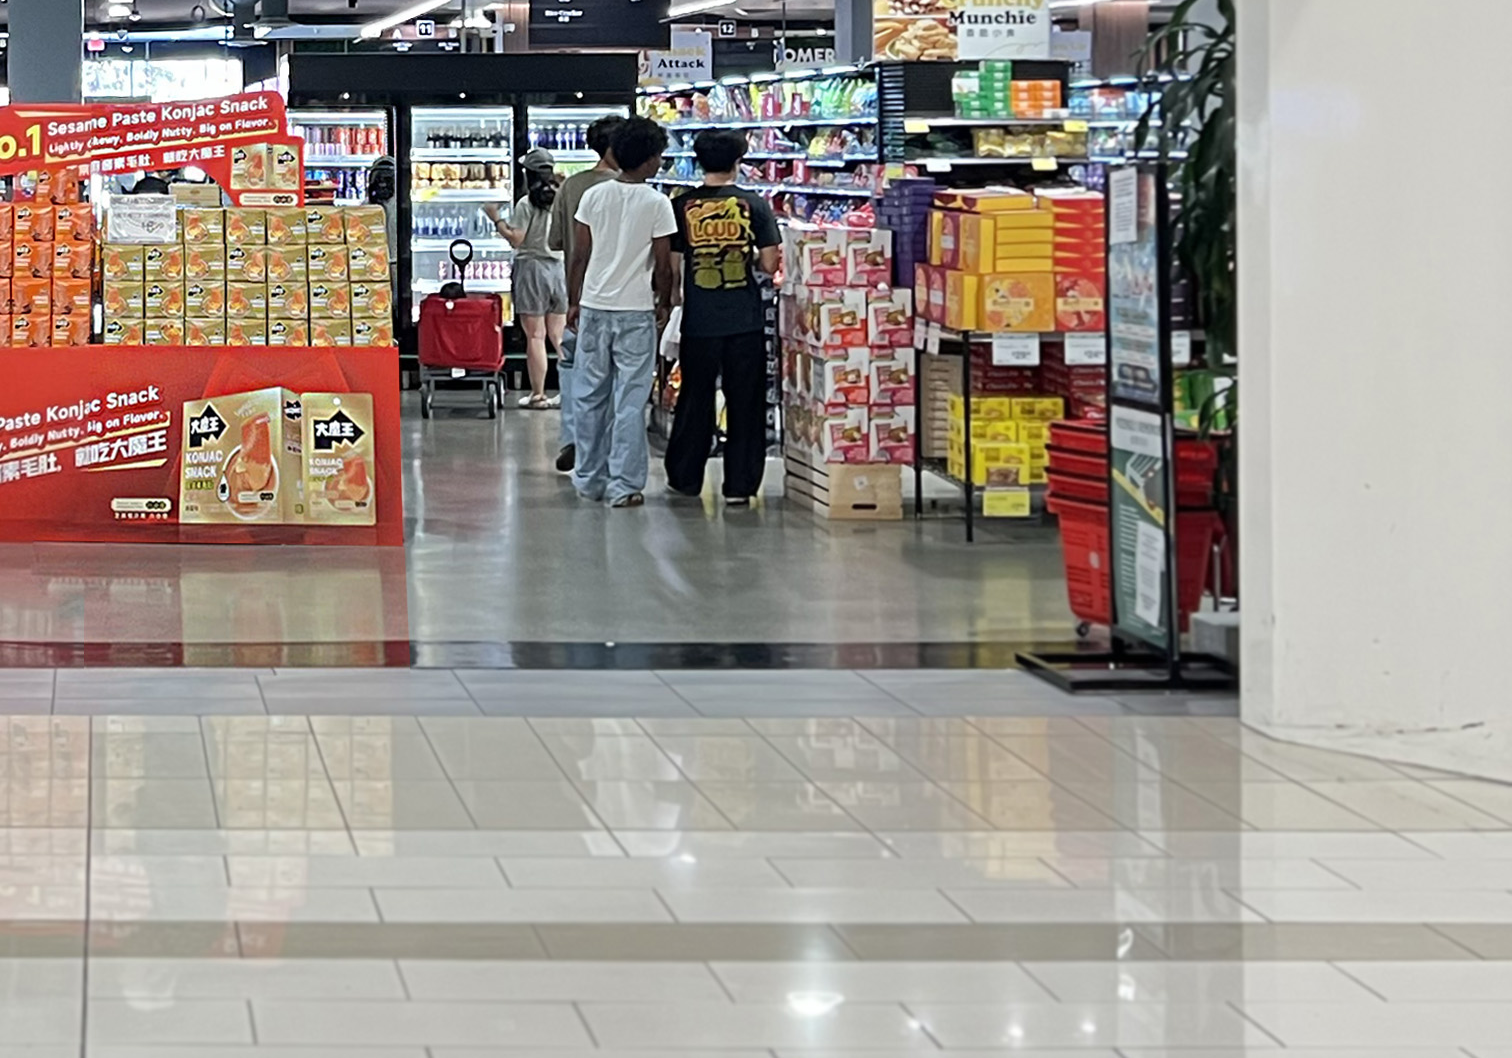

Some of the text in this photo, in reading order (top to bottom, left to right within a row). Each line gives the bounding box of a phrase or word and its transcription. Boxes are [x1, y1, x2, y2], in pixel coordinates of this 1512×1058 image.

[720, 23, 735, 35] 12
[949, 10, 1038, 25] Munchie
[657, 57, 705, 69] Attack
[47, 95, 269, 137] Sesame Paste Konjac Snack
[48, 140, 85, 155] Lightly
[126, 128, 159, 145] Boldly
[199, 121, 217, 135] Big
[219, 122, 233, 132] on
[235, 117, 273, 130] Flavor.
[692, 219, 740, 240] LOUD
[46, 399, 101, 422] Konjac
[106, 385, 159, 409] Snack
[10, 433, 45, 450] Boldly
[106, 418, 120, 429] on
[123, 409, 164, 426] Flavor.
